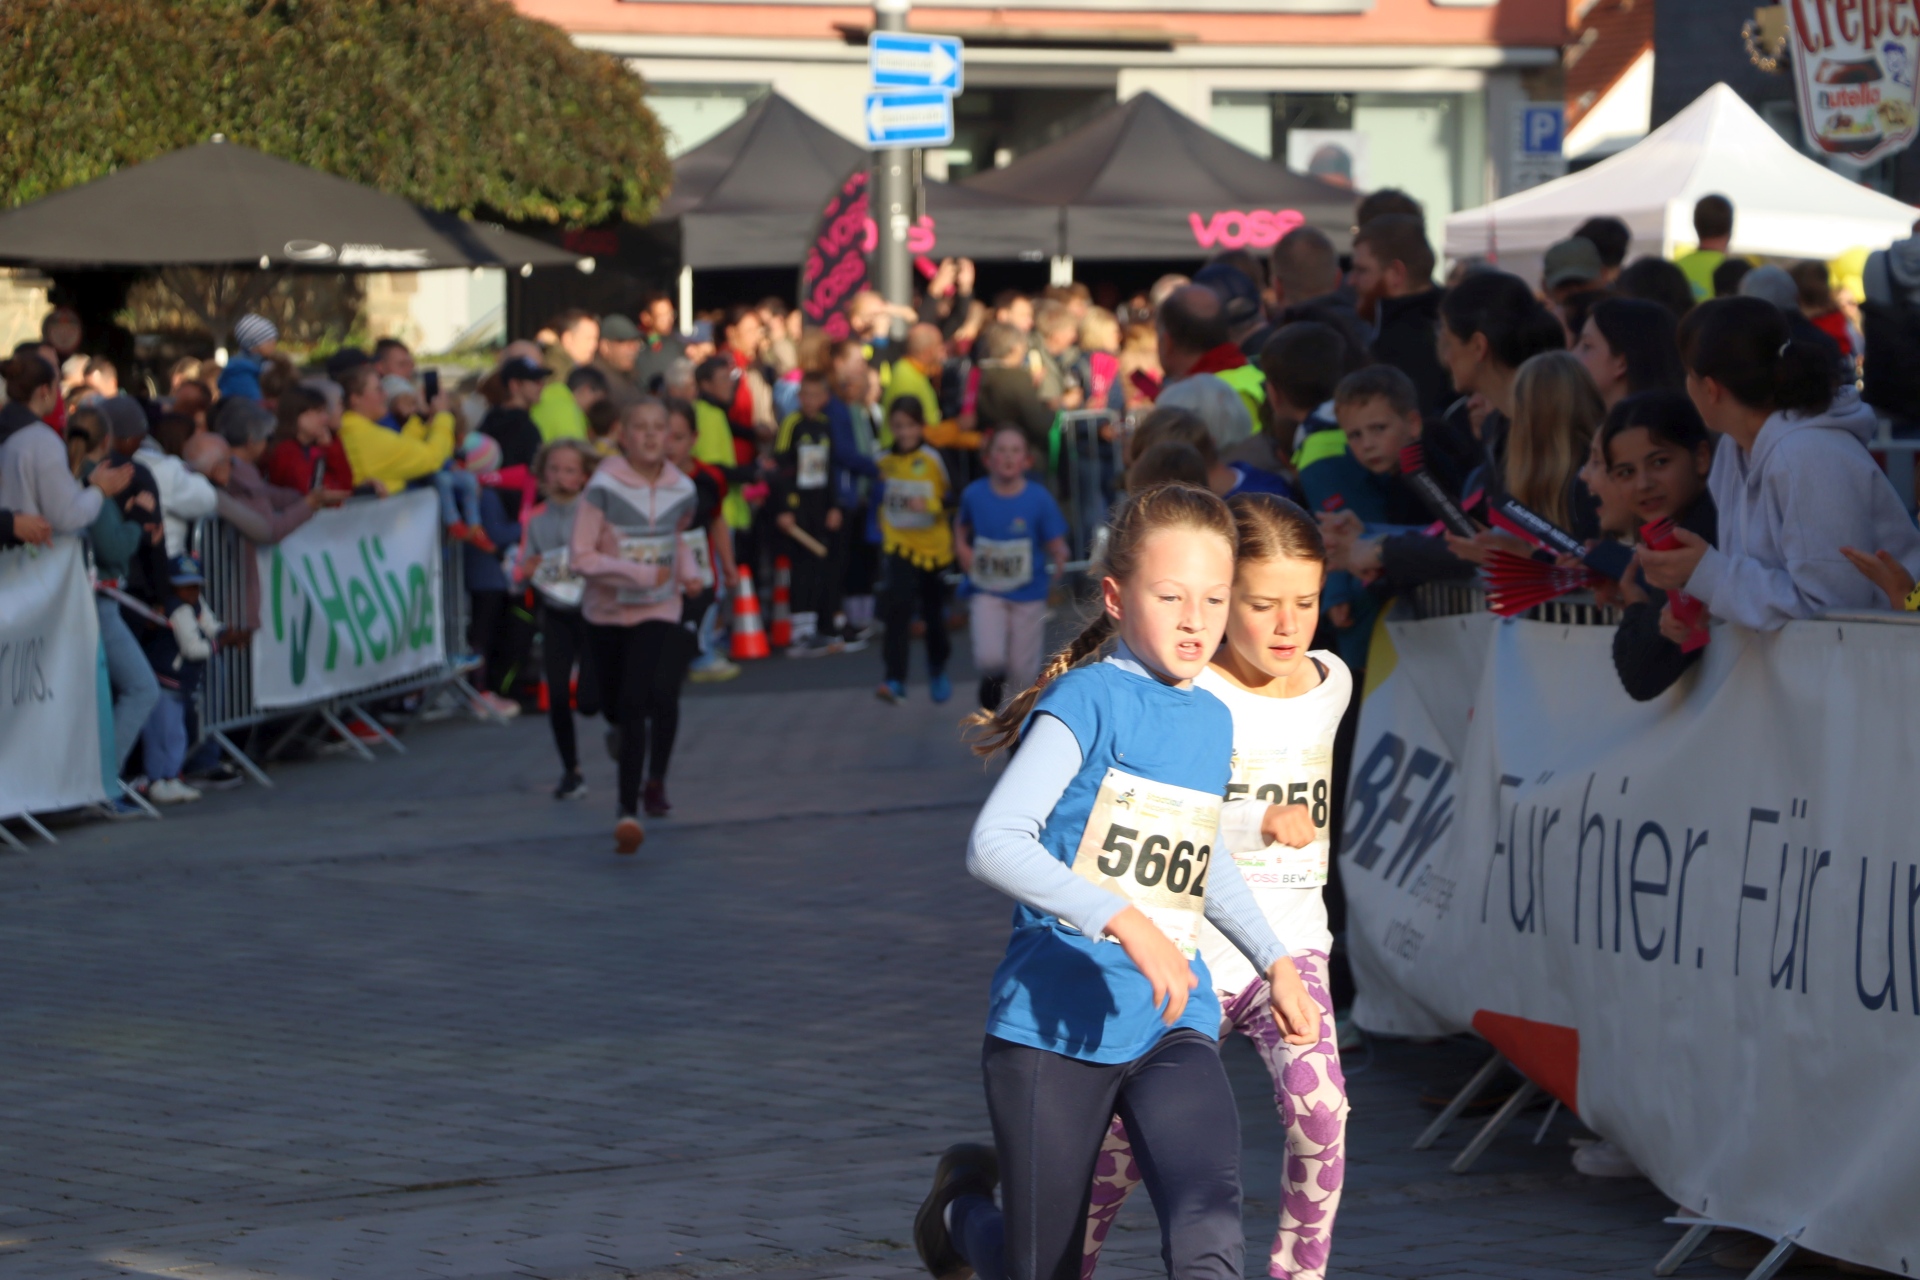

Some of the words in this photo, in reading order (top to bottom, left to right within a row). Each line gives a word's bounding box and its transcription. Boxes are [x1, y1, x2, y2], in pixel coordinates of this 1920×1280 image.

[1819, 82, 1881, 110] nutella
[1530, 111, 1556, 149] P
[1188, 209, 1305, 250] VOSS
[1340, 730, 1456, 888] BEW
[1097, 822, 1211, 898] 5662
[1243, 873, 1279, 884] VOSS
[1282, 873, 1308, 884] BEW
[1481, 771, 1561, 937] Für
[1574, 772, 1709, 970] hier.
[1735, 797, 1832, 995] Für
